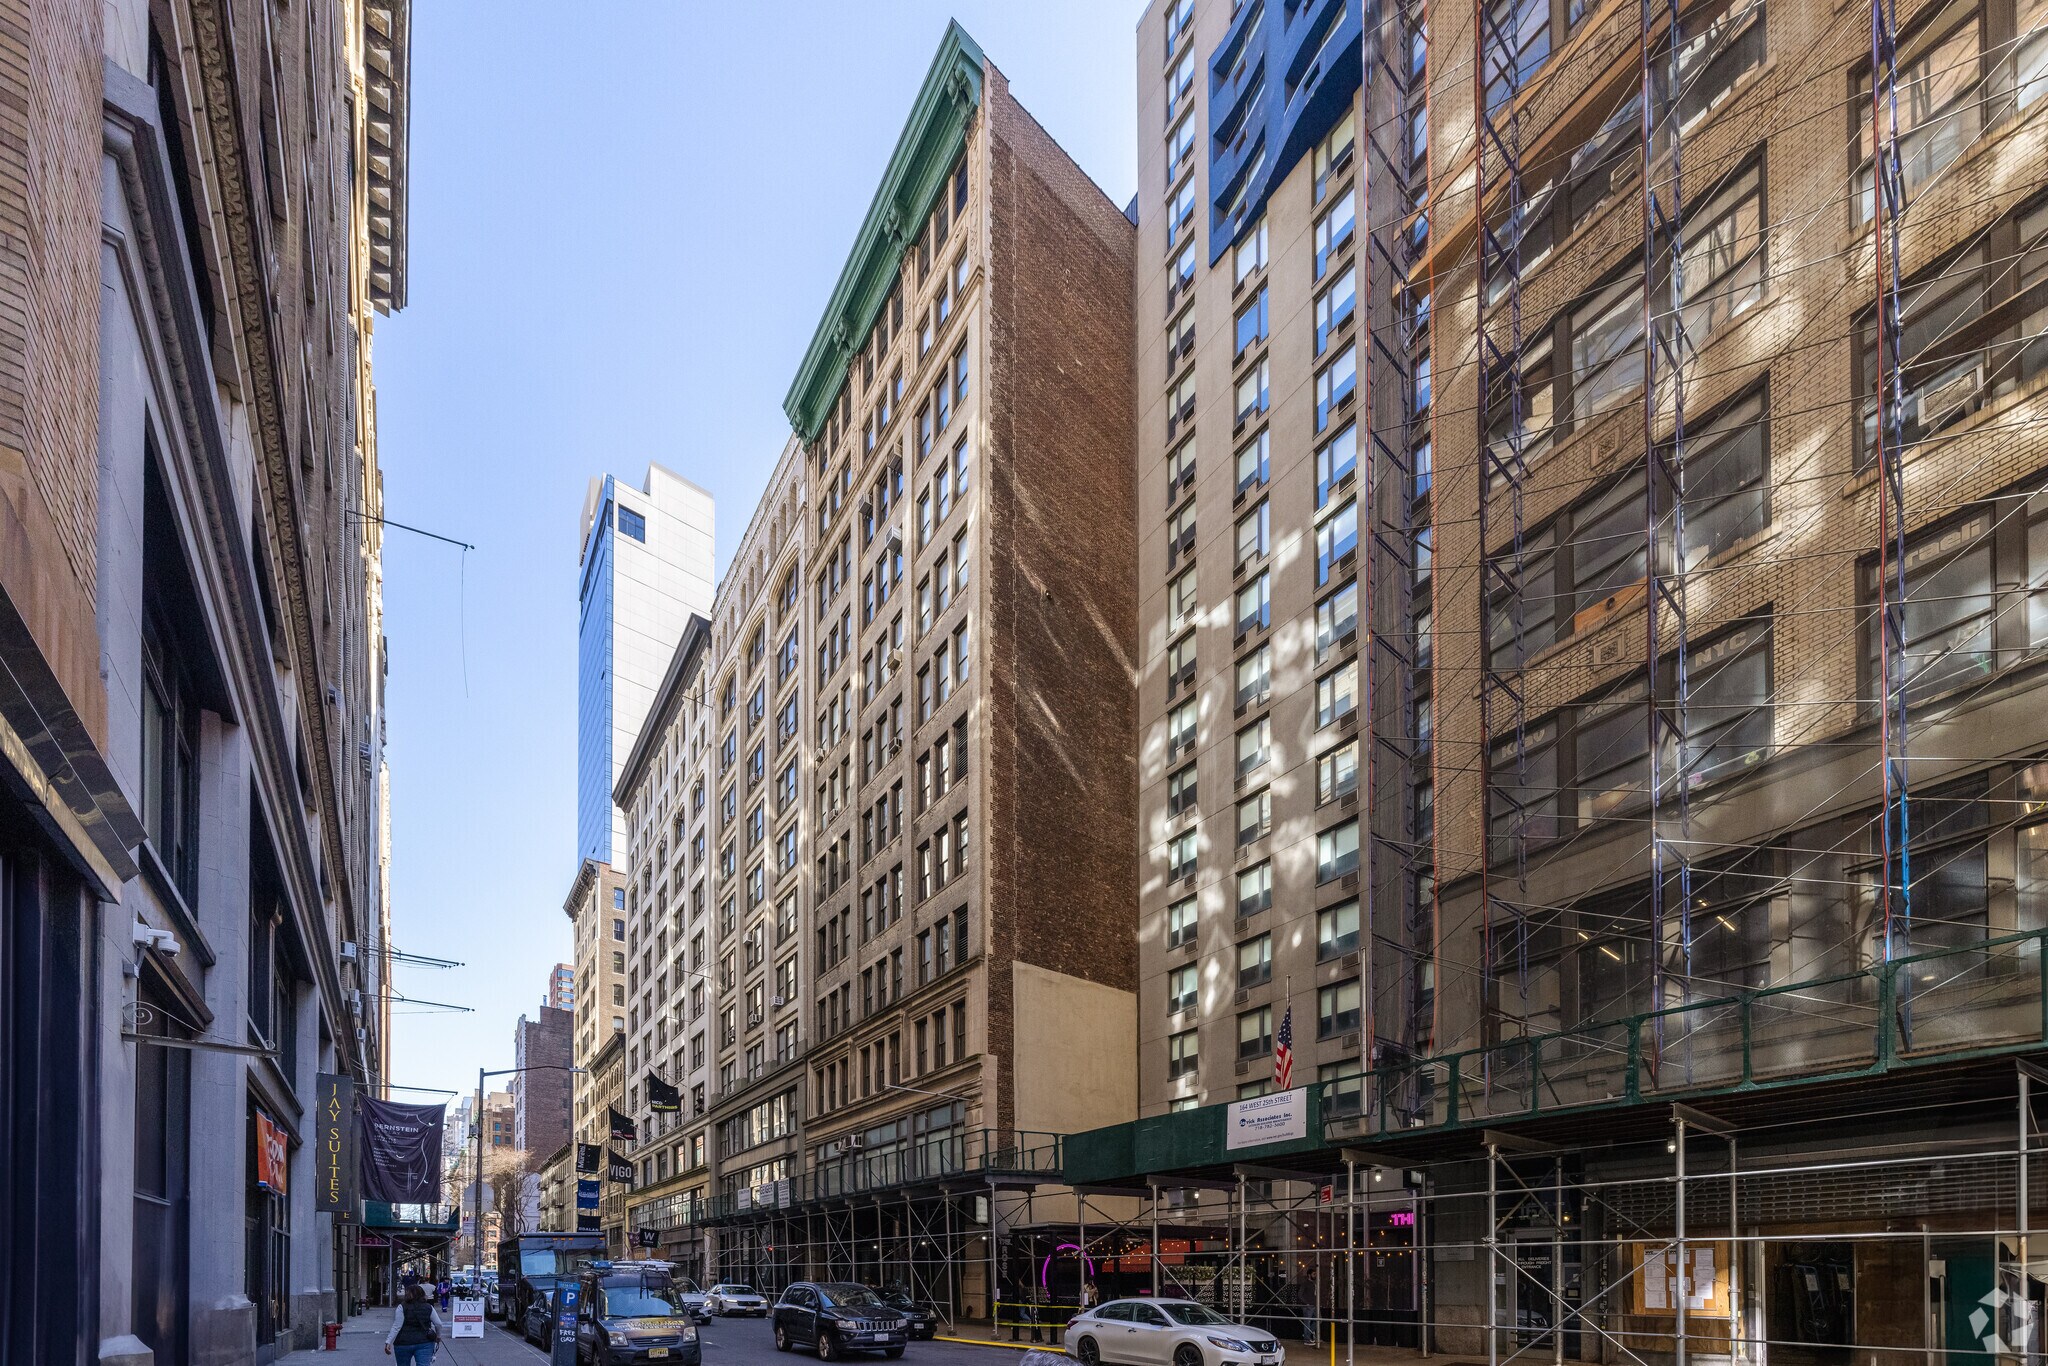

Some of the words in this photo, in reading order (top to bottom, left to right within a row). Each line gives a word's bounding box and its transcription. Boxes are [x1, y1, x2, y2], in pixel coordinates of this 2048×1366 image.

[1695, 631, 1747, 667] NYC
[329, 1084, 341, 1121] JAY
[1239, 1103, 1248, 1111] 164
[1249, 1101, 1262, 1109] WEST
[1262, 1098, 1274, 1106] 25th
[1274, 1094, 1292, 1104] STREET
[1257, 1114, 1282, 1123] Associates
[329, 1128, 340, 1203] SUITES
[609, 1165, 632, 1180] VIGO
[1391, 1213, 1415, 1226] TH
[644, 1231, 655, 1241] W
[566, 1292, 576, 1304] P
[457, 1303, 480, 1313] JAY
[559, 1329, 576, 1337] FREE
